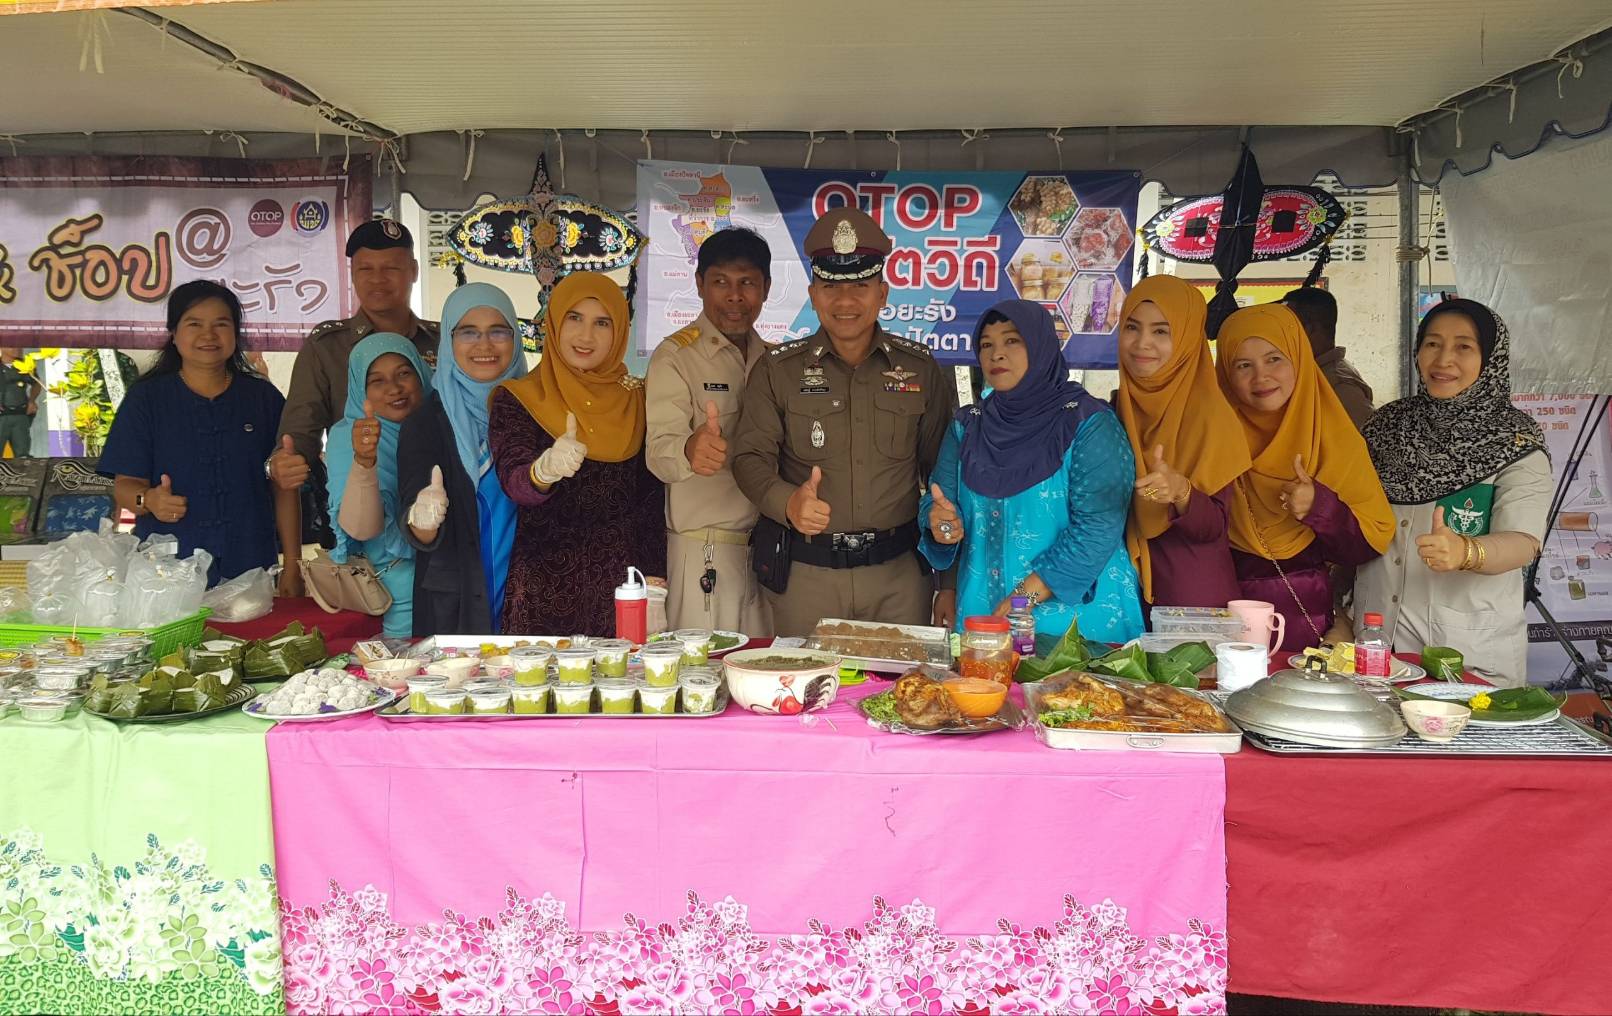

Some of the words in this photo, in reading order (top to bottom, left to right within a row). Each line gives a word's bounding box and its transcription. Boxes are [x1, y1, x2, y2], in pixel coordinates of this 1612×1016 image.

[250, 211, 282, 221] OTOP
[812, 181, 982, 232] OTOP
[882, 234, 1000, 291] ตวิถี
[879, 298, 957, 322] อยะรัง
[1537, 407, 1554, 416] 250
